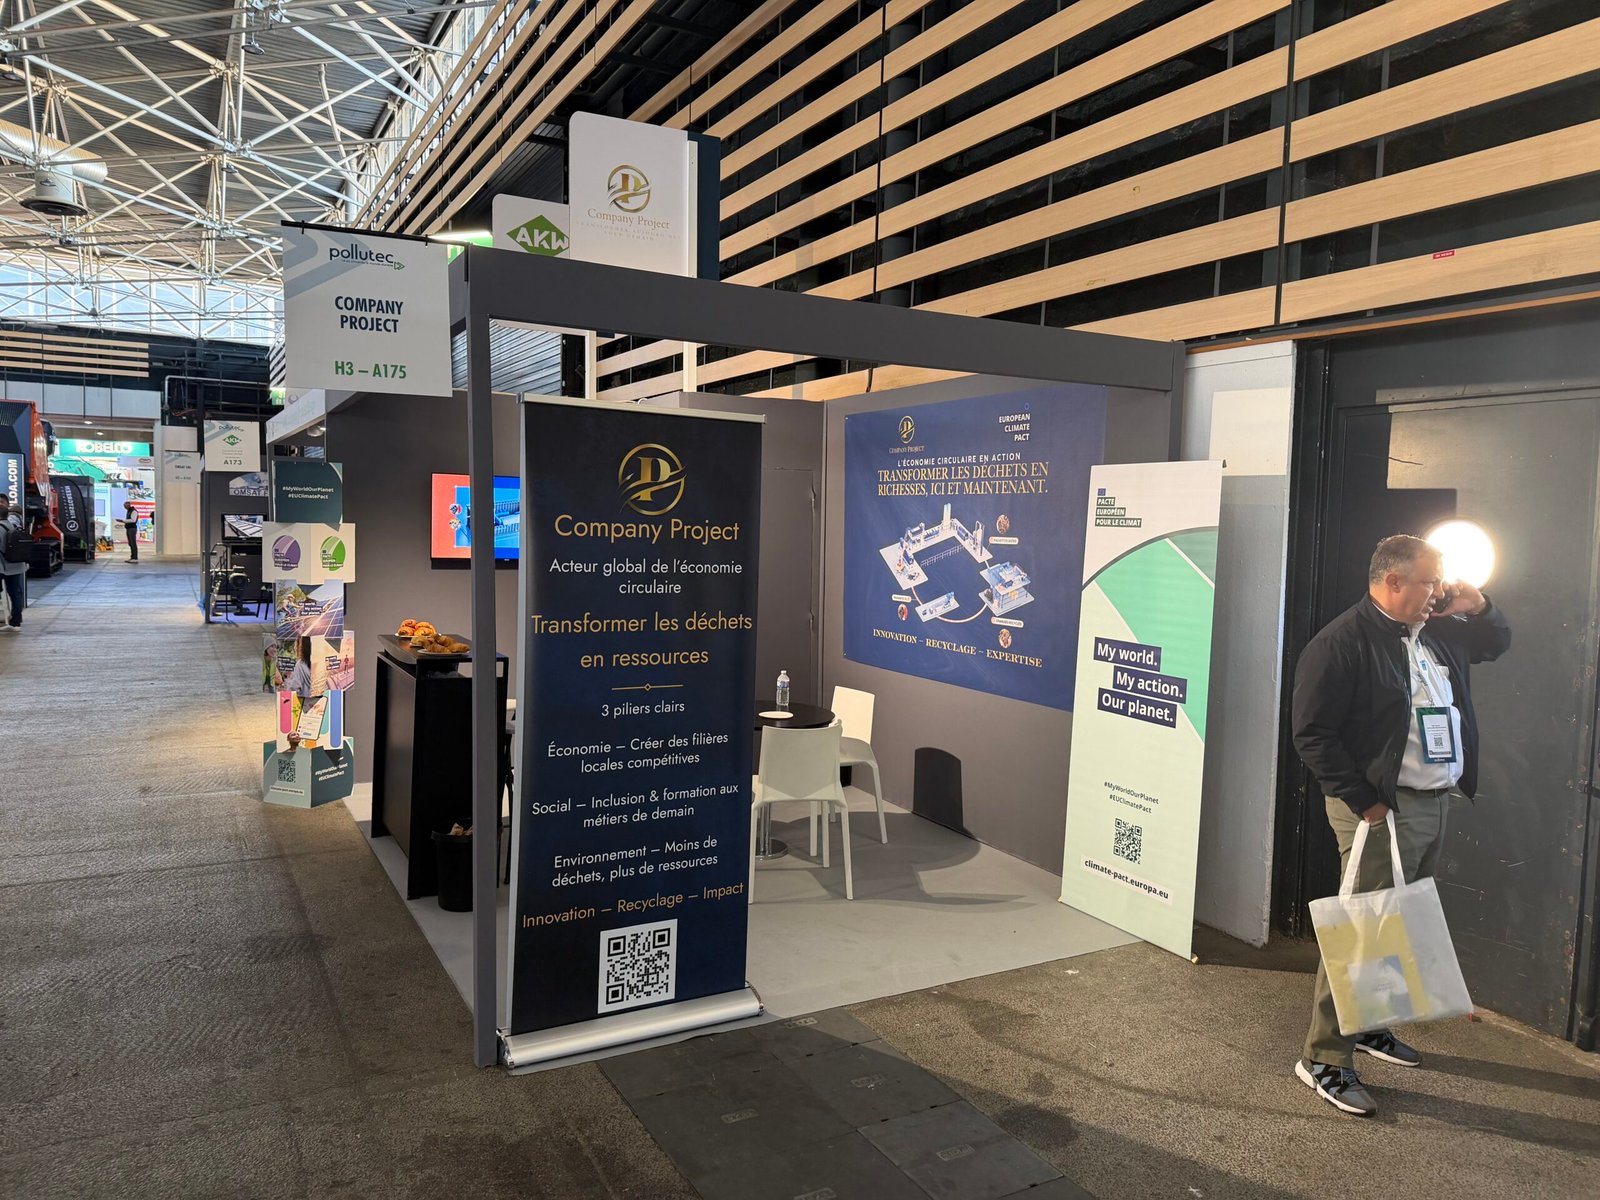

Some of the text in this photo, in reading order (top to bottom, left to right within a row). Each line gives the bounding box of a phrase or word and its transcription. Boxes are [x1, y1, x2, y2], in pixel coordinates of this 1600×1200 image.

[587, 208, 670, 230] Company Project
[515, 227, 569, 250] AKW
[330, 244, 394, 263] pollutec
[335, 296, 403, 315] COMPANY
[340, 315, 399, 332] PROJECT
[335, 361, 354, 376] H3
[372, 363, 407, 379] A175
[999, 413, 1030, 424] EUROPEAN
[1004, 424, 1030, 432] CLIMATE
[76, 440, 133, 454] KOBELCO
[1014, 434, 1030, 442] PACT
[898, 452, 1020, 467] L'ÉCONOMIE CIRCULAIRE EN ACTION
[878, 462, 1048, 482] TRANSFORMER LES DÉCHETS EN
[878, 480, 1048, 497] RICHESSES, ICI ET MAINTENANT.
[554, 514, 740, 545] Company Project
[550, 558, 742, 576] Acteur global de l'économie
[619, 579, 682, 594] circulaire
[532, 610, 752, 634] Transformer les déchets
[873, 628, 918, 644] INNOVATION
[926, 638, 976, 655] RECYCLAGE
[986, 649, 1043, 667] EXPERTISE
[1097, 643, 1157, 666] My world.
[580, 650, 709, 668] en ressources
[1116, 672, 1183, 698] My action.
[602, 700, 685, 718] 3 piliers clairs
[1102, 693, 1174, 722] Our planet.
[548, 741, 611, 757] Économie
[630, 736, 664, 751] Créer
[668, 735, 688, 748] des
[692, 732, 728, 746] filières
[581, 753, 700, 773] locales compétitives
[532, 799, 571, 815] Social
[592, 792, 645, 808] Inclusion
[650, 790, 660, 802] &
[663, 786, 716, 800] formation
[720, 784, 739, 794] aux
[1104, 781, 1159, 804] #MyWorldOurPlanet
[1109, 794, 1152, 814] #EUClimatePact
[583, 806, 694, 828] métiers de demain
[554, 846, 646, 868] Environnement
[664, 840, 699, 853] Moins
[703, 835, 718, 848] de
[552, 854, 718, 887] déchets, plus de ressources
[1085, 860, 1169, 899] climate-pact.europa.eu
[523, 908, 595, 928] Innovation
[618, 892, 684, 913] Recyclage
[703, 882, 744, 900] Impact
